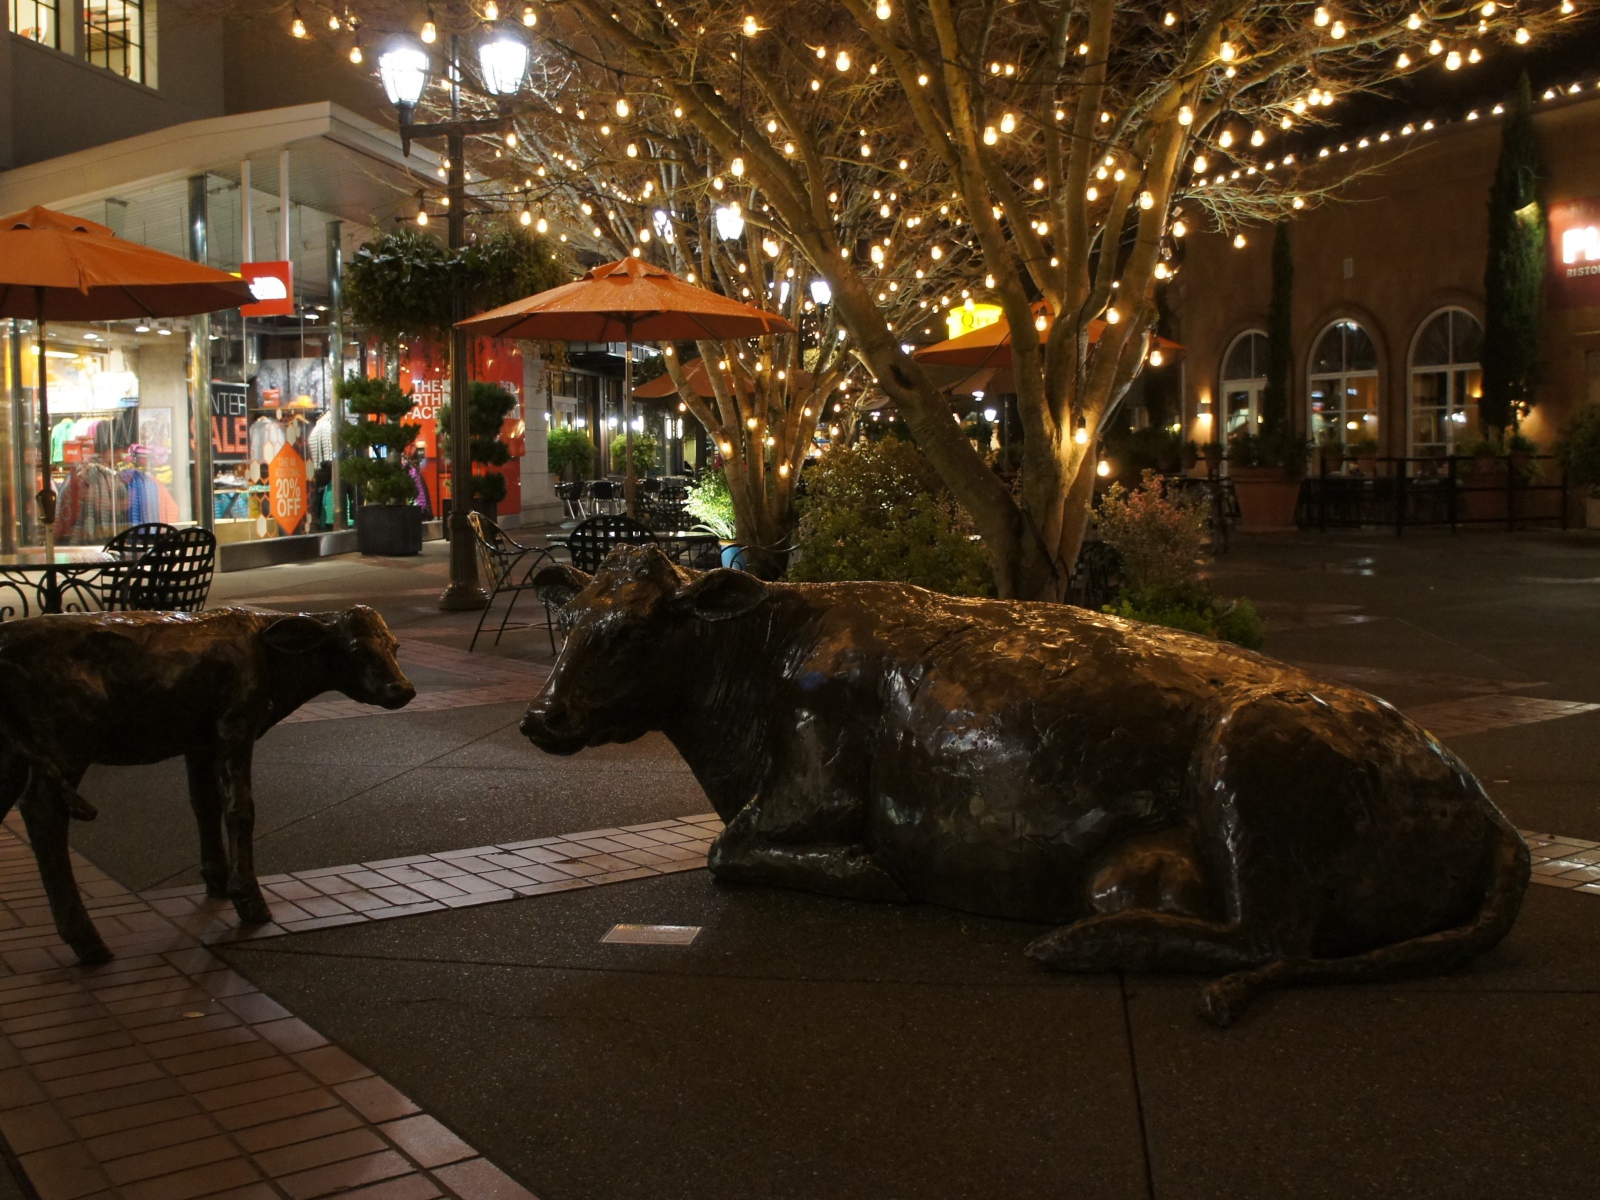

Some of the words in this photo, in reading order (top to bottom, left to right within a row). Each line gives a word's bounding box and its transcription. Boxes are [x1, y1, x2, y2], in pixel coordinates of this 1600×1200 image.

[412, 380, 441, 393] THE
[412, 393, 441, 406] RTH
[276, 478, 301, 499] 20%
[277, 497, 301, 517] OFF
